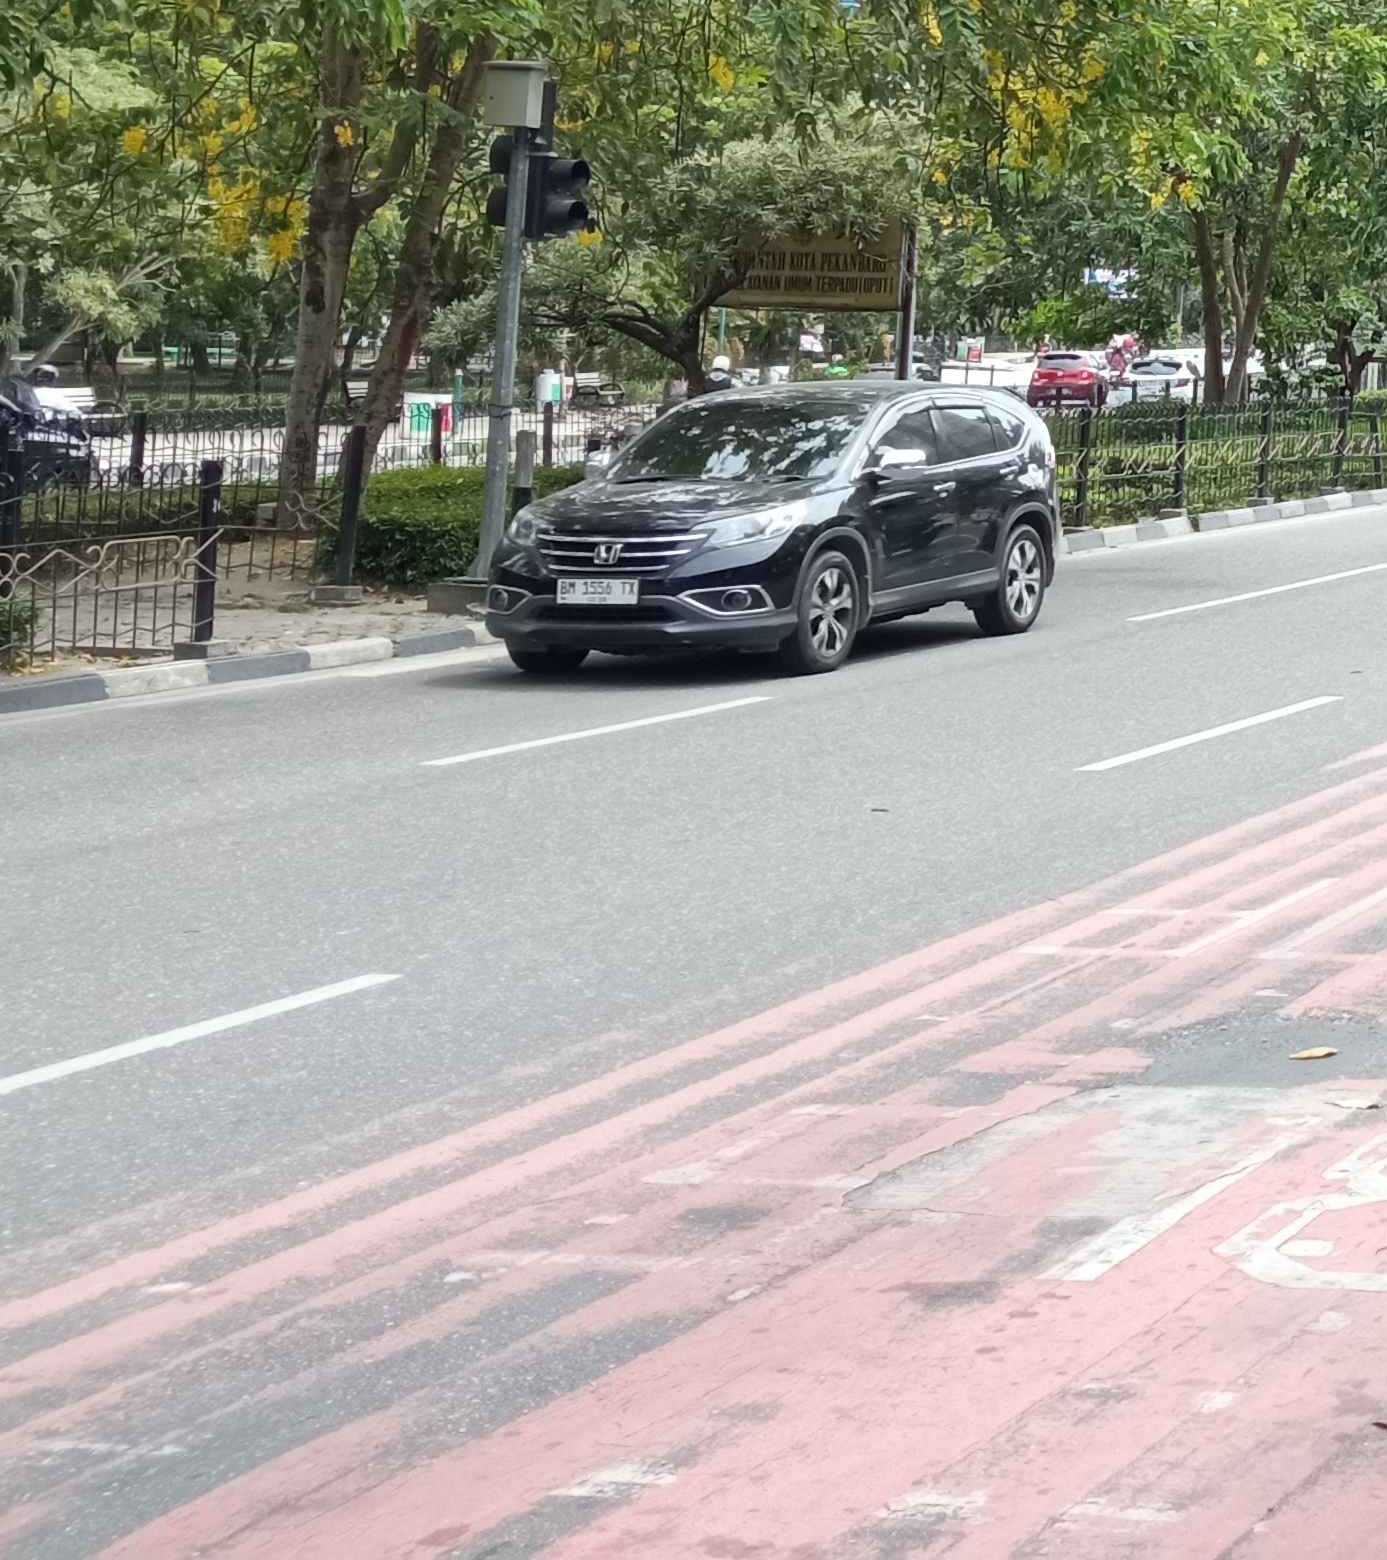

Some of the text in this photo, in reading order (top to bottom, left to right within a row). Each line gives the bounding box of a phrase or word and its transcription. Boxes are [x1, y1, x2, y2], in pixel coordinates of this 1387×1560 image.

[789, 252, 816, 271] KOTA
[784, 275, 812, 292] UMUM
[560, 581, 635, 596] BM 1556 TX
